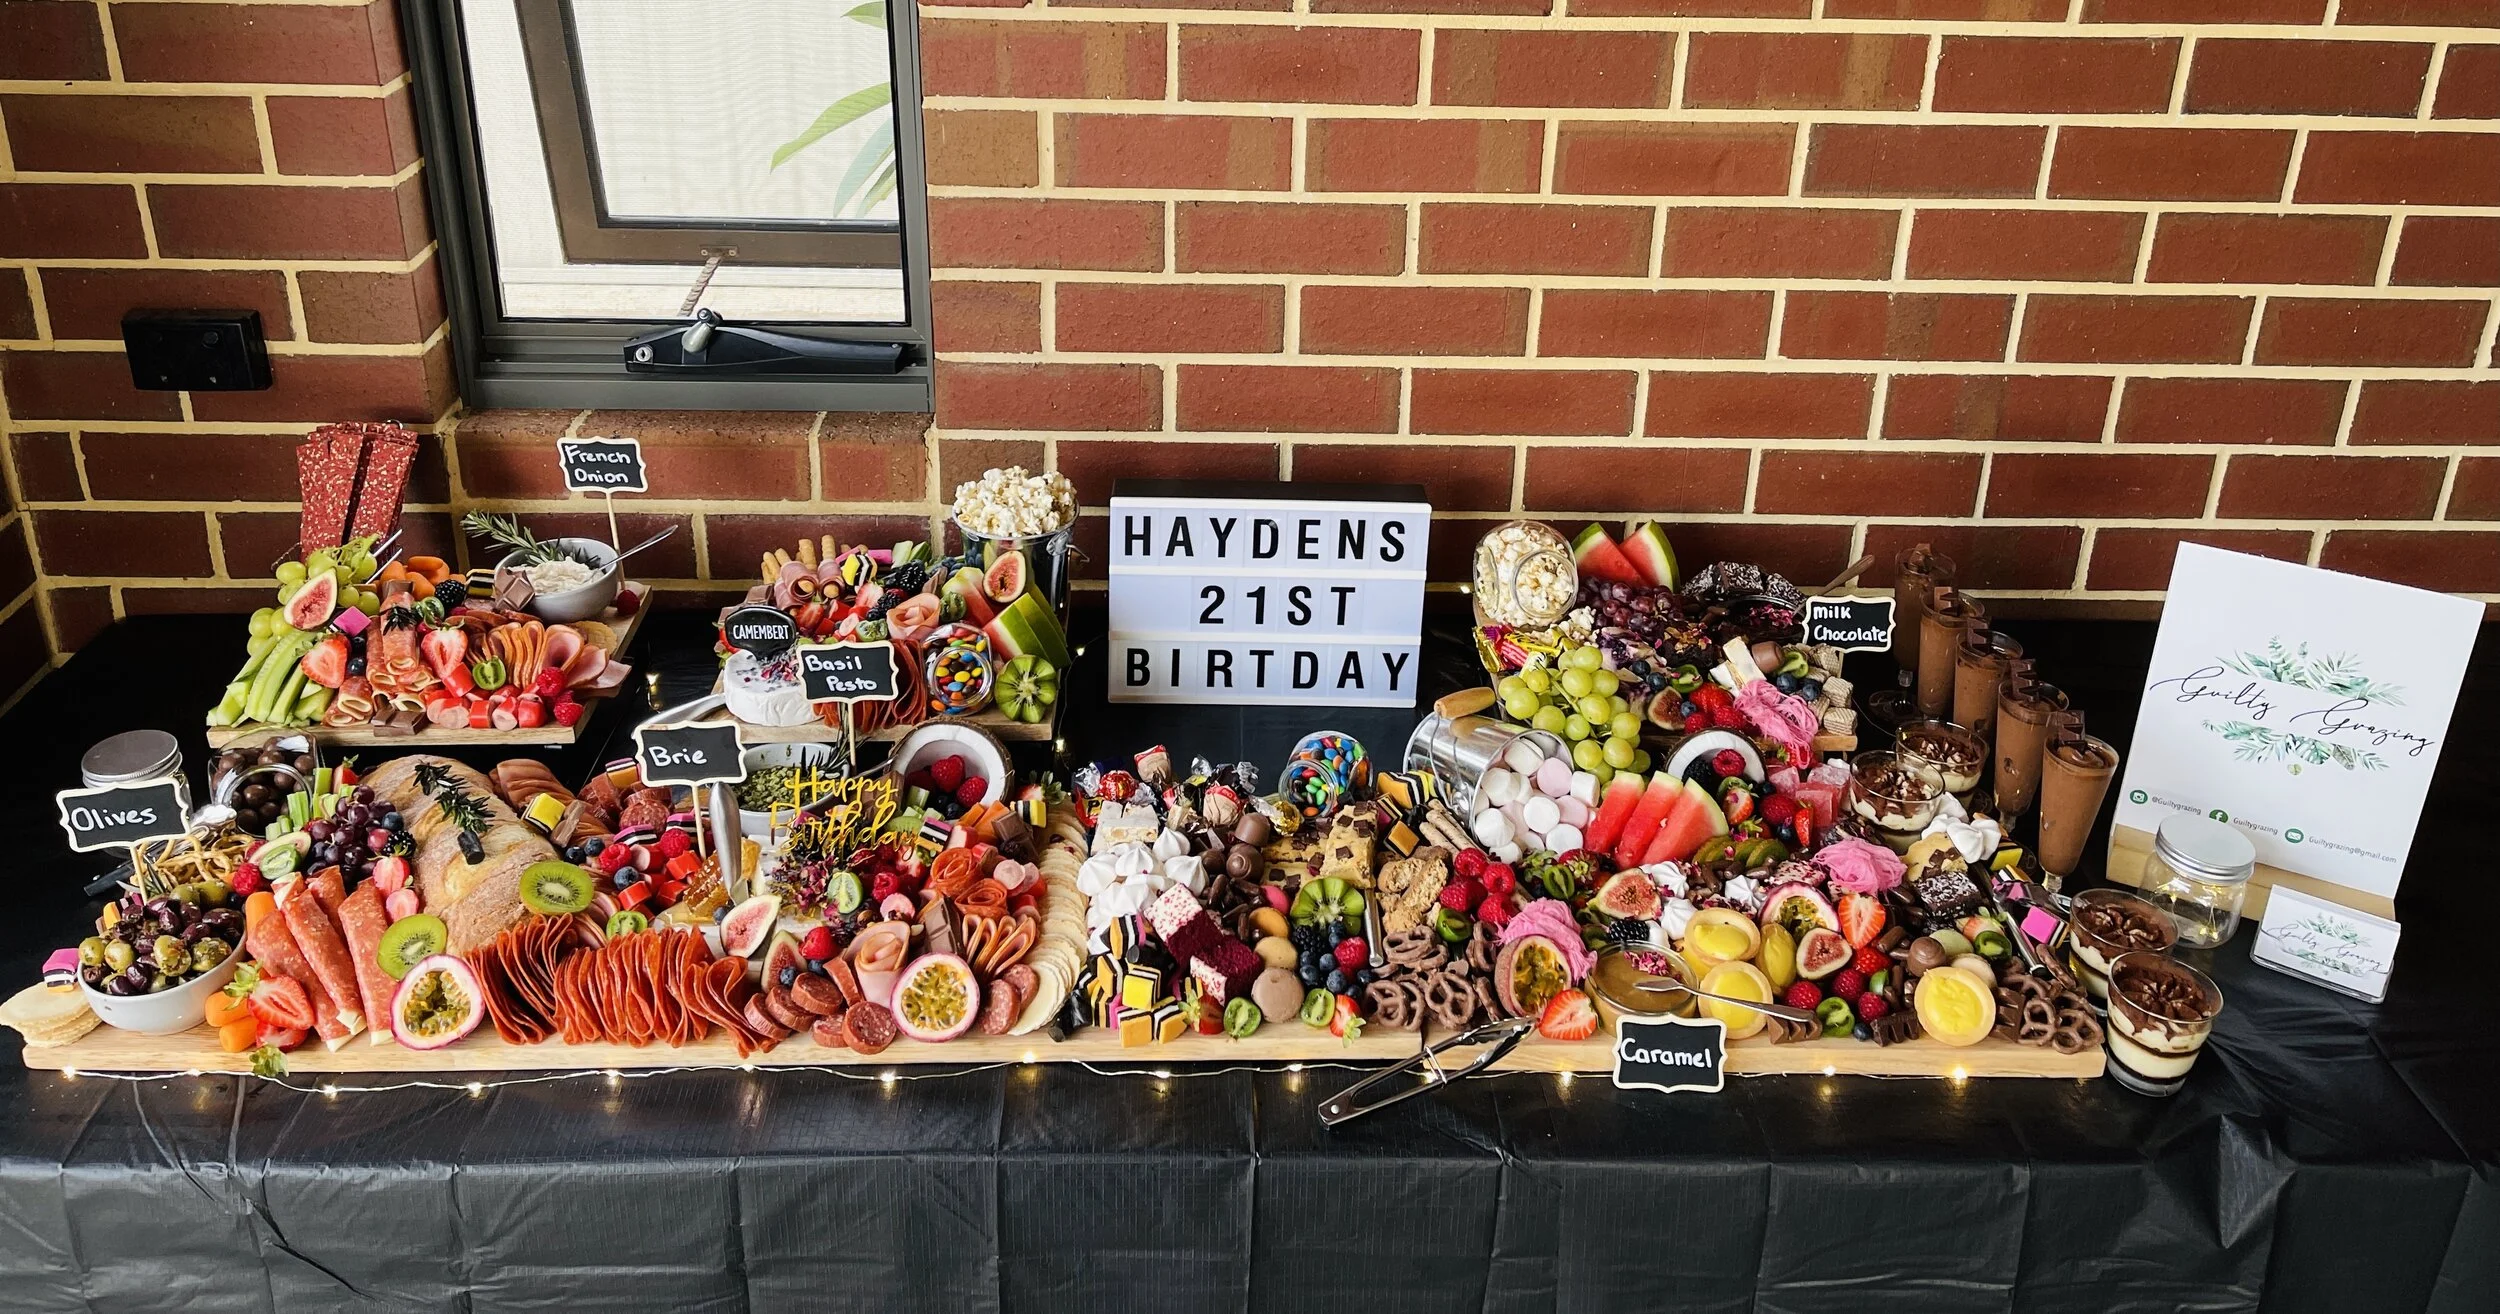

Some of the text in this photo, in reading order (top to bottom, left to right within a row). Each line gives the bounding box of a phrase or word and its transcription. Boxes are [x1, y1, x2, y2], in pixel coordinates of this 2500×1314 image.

[564, 444, 631, 464] French
[574, 468, 629, 483] Onion
[1124, 516, 1405, 562] HAYDENS
[1199, 585, 1356, 626] 21ST
[732, 624, 789, 640] CAMEMBERT
[1813, 624, 1888, 642] Chocolate
[804, 654, 863, 672] Basil
[1126, 648, 1410, 691] BIRTDAY
[825, 675, 878, 692] Pesto
[2150, 666, 2435, 756] Guilty Grazing
[648, 745, 707, 767] Brie
[784, 765, 898, 808] Happy
[2151, 795, 2202, 816] @Guiltygrazing
[71, 806, 158, 831] Olives
[2232, 816, 2279, 836] Guiltygrazing
[768, 800, 918, 861] Birthday
[2308, 835, 2398, 864] Guiltygrazing@gmail.com
[1620, 1037, 1712, 1068] Caramel
